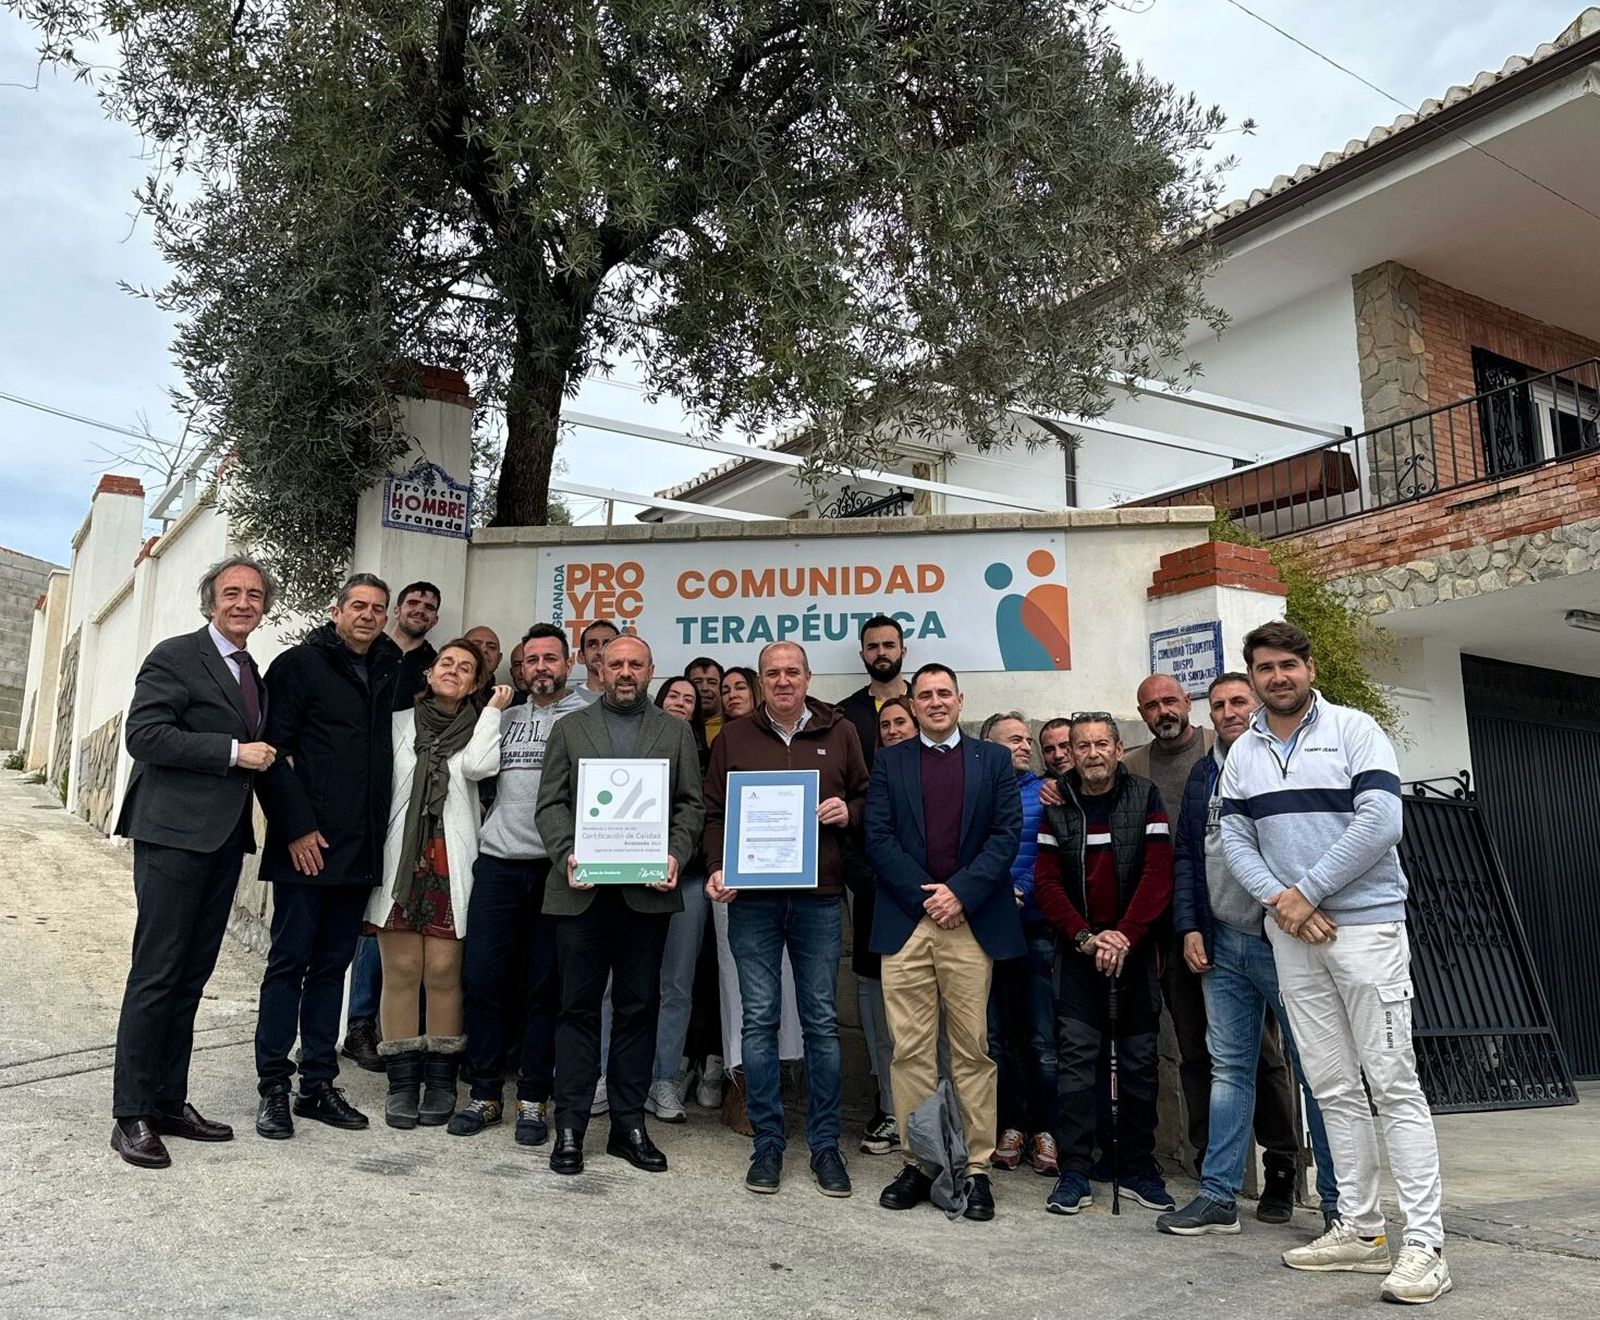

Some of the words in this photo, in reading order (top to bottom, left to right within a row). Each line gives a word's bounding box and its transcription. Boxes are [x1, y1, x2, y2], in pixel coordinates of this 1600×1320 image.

[391, 492, 466, 520] HOMBRE
[391, 509, 463, 531] Granada
[566, 561, 645, 592] PRO
[677, 564, 945, 600] COMUNIDAD
[552, 564, 565, 630] GRANADA
[566, 590, 644, 619] YEC
[676, 604, 947, 645] TERAPÉUTCA
